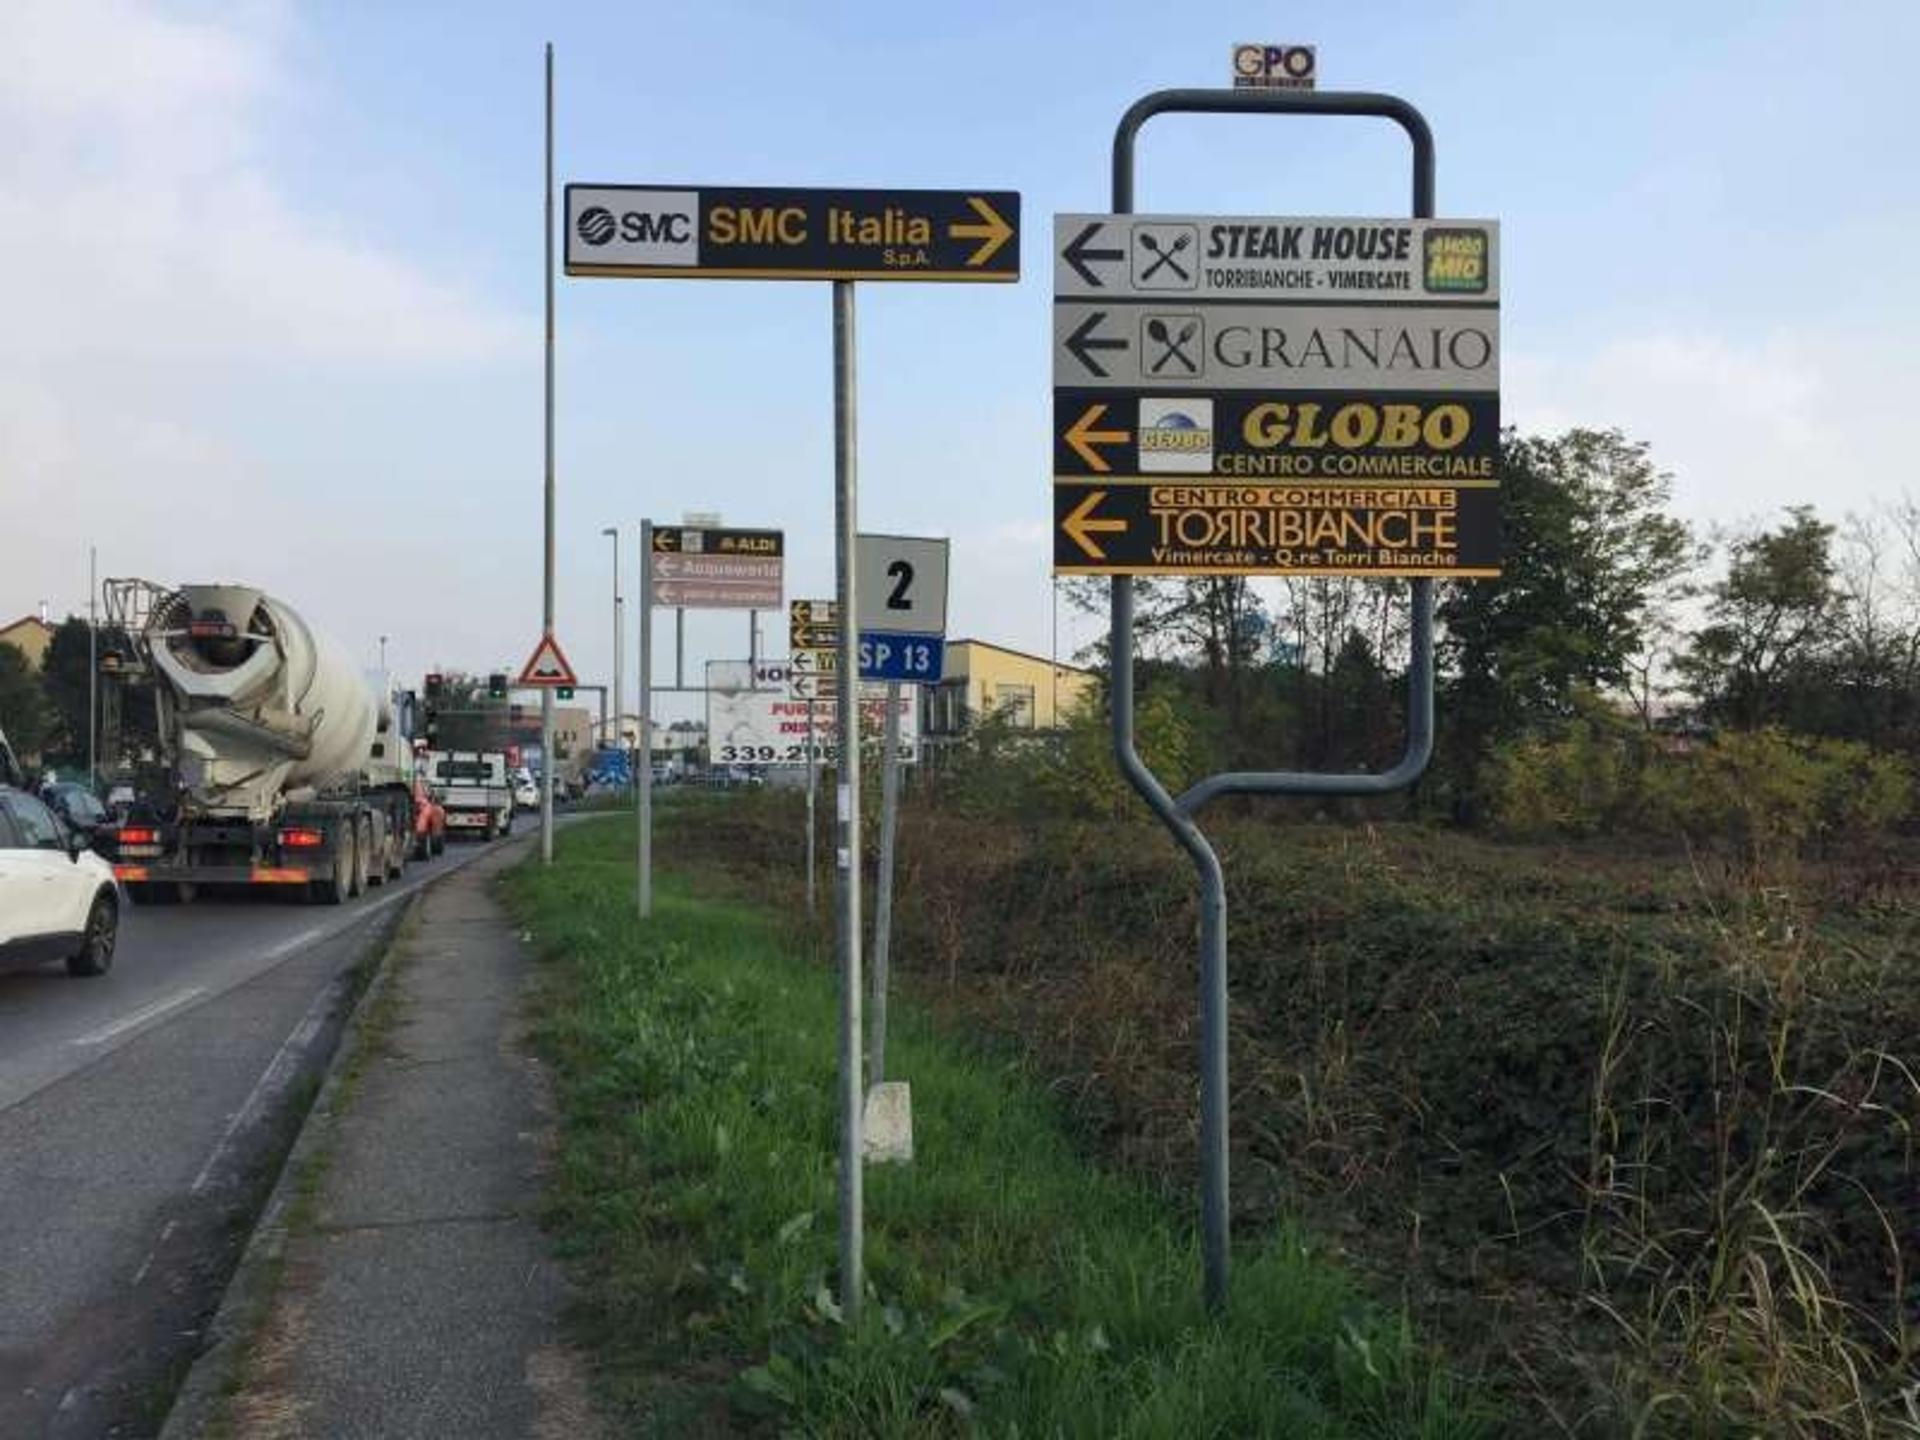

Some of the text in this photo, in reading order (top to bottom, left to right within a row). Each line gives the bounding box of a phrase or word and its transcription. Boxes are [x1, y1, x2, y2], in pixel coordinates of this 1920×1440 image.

[1235, 46, 1315, 77] GPO
[621, 211, 690, 244] SMC
[708, 206, 931, 246] SMC Italia
[1207, 225, 1304, 260] STEAK
[1311, 227, 1412, 261] HOUSE
[1205, 268, 1314, 289] TORRIBIANCHE
[1327, 270, 1411, 290] VIMERCATE
[1213, 325, 1492, 370] GRANAIO
[1242, 402, 1471, 450] GLOBO
[1216, 452, 1493, 477] CENTRO COMMERCIALE
[1153, 488, 1456, 508] CENTRO COMMERCIALE
[1151, 548, 1256, 566] Vimercate
[1326, 550, 1372, 566] Torri
[1378, 551, 1457, 567] Bianche
[886, 560, 915, 611] 2
[859, 642, 892, 670] SP
[904, 644, 931, 671] 13
